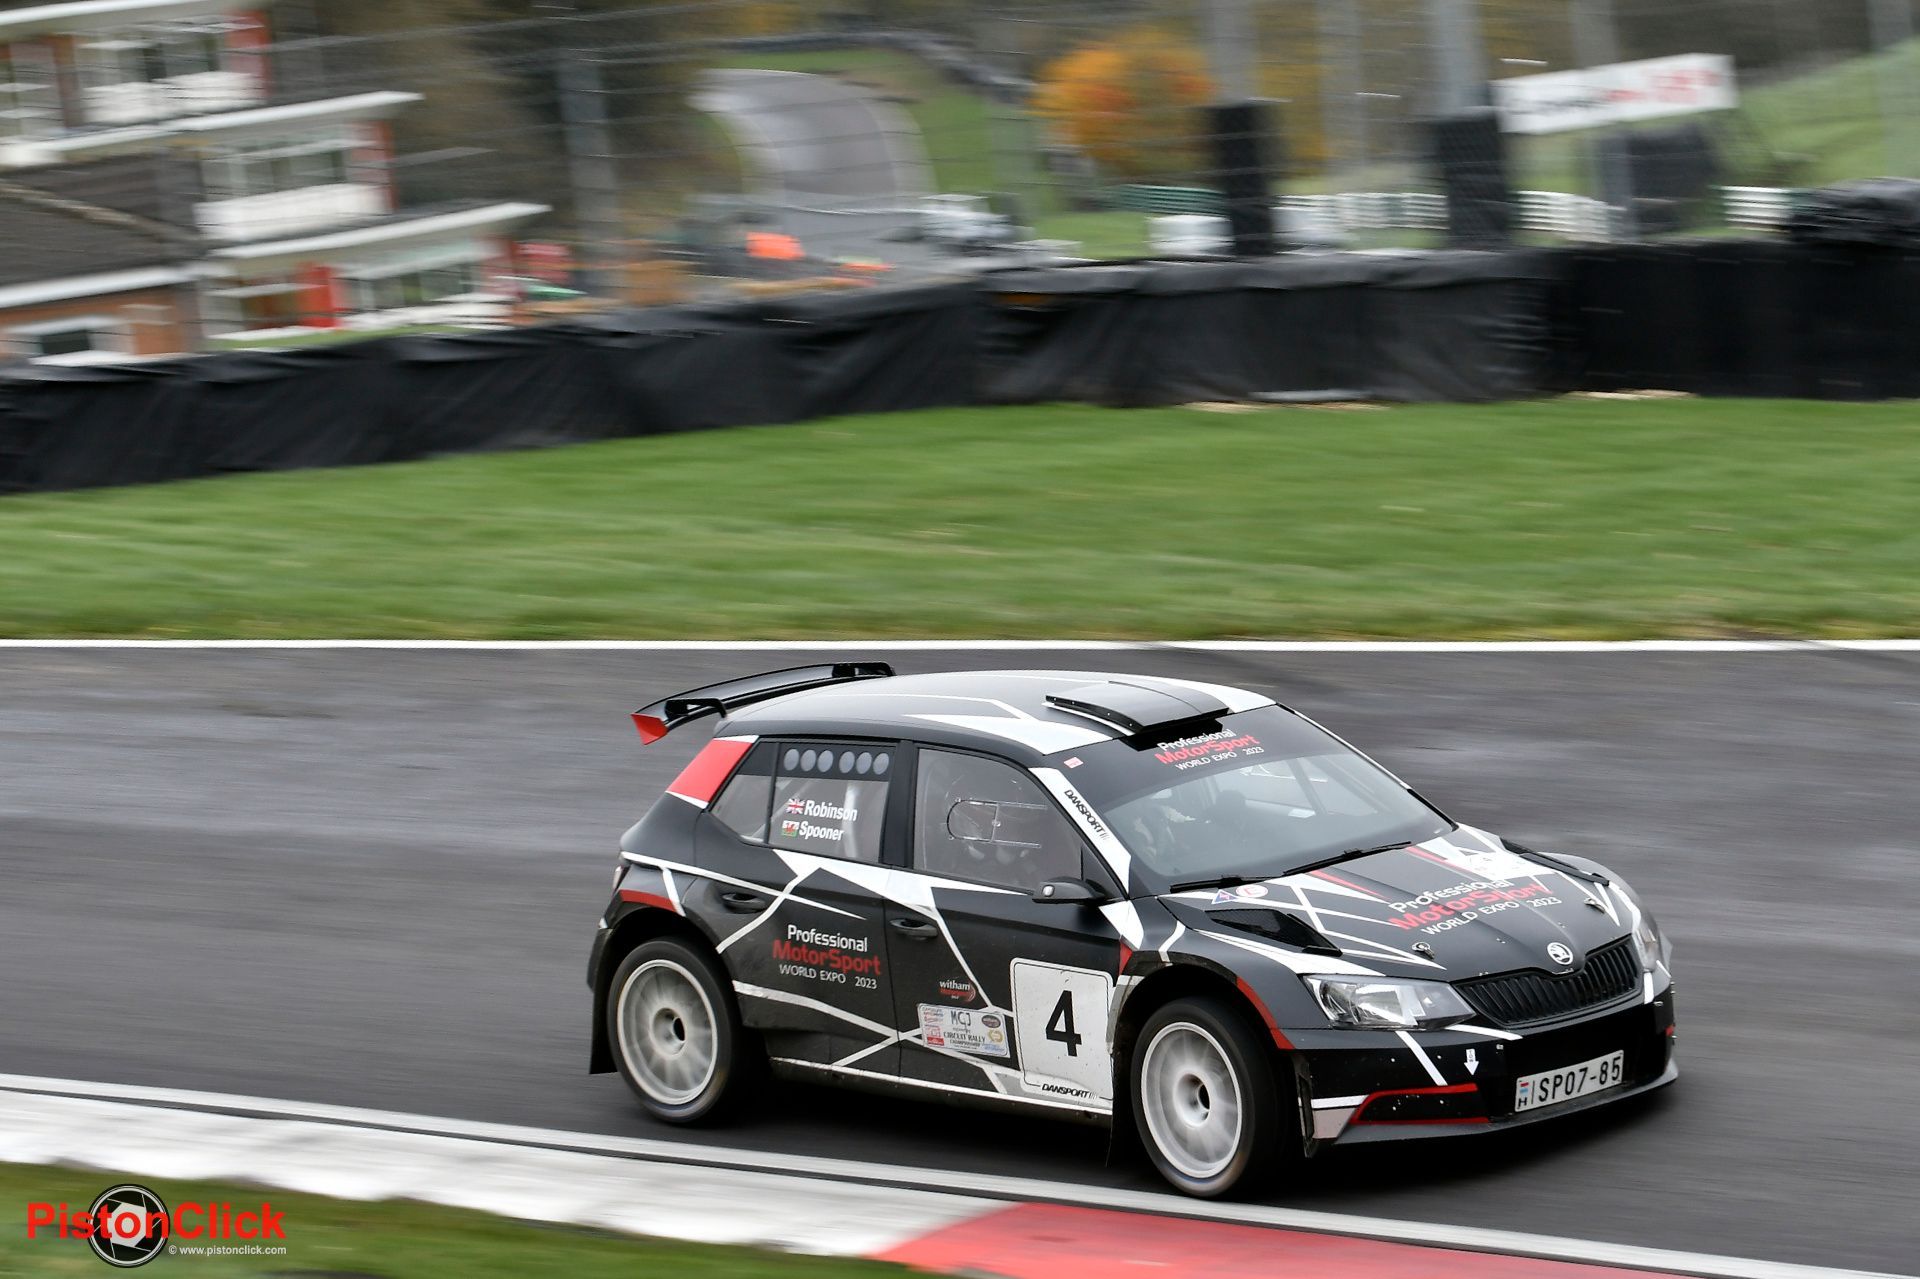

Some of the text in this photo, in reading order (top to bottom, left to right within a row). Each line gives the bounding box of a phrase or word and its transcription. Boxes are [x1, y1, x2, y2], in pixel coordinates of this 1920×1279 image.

[1155, 735, 1260, 764] MotorSport
[1157, 729, 1236, 751] Professional
[1176, 746, 1264, 771] WORLD EXPO 2023
[804, 800, 858, 821] Robinson
[1064, 789, 1106, 833] DANSPORT
[799, 821, 844, 841] Spooner
[1387, 883, 1553, 932] MotorSport
[1388, 879, 1515, 914] Professional
[1421, 896, 1562, 936] WORLD EXPO 2023
[787, 924, 868, 953] Professional
[772, 938, 881, 976] MotorSport
[779, 964, 878, 990] WORLD EXPO 2023
[939, 979, 970, 991] witham
[1045, 990, 1082, 1057] 4
[1042, 1083, 1090, 1099] DANSPORT
[1538, 1056, 1622, 1103] SP07-85
